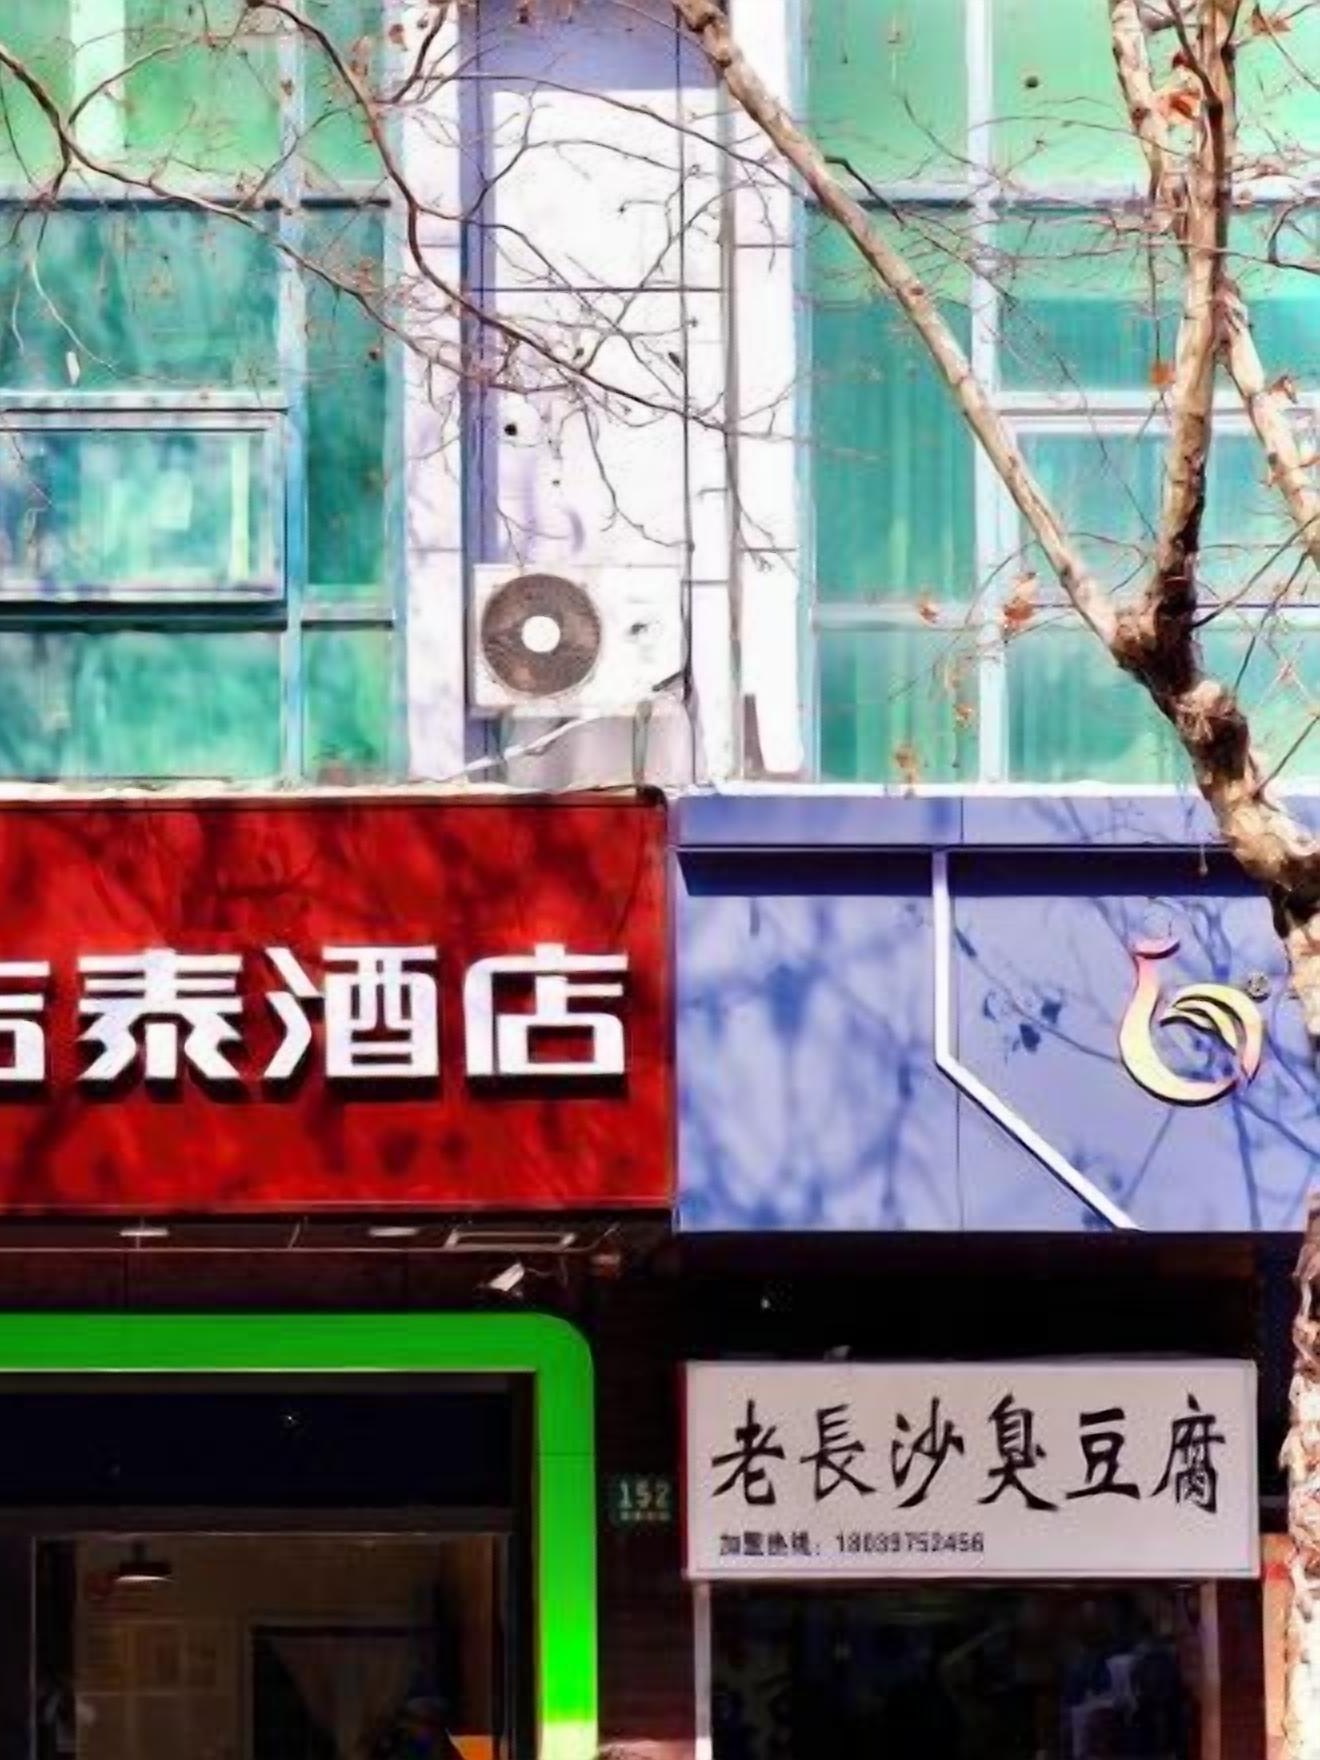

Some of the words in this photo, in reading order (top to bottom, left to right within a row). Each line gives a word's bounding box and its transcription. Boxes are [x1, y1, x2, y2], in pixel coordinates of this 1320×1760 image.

[711, 1393, 1226, 1514] 老長沙臭豆腐
[617, 1479, 670, 1509] 152
